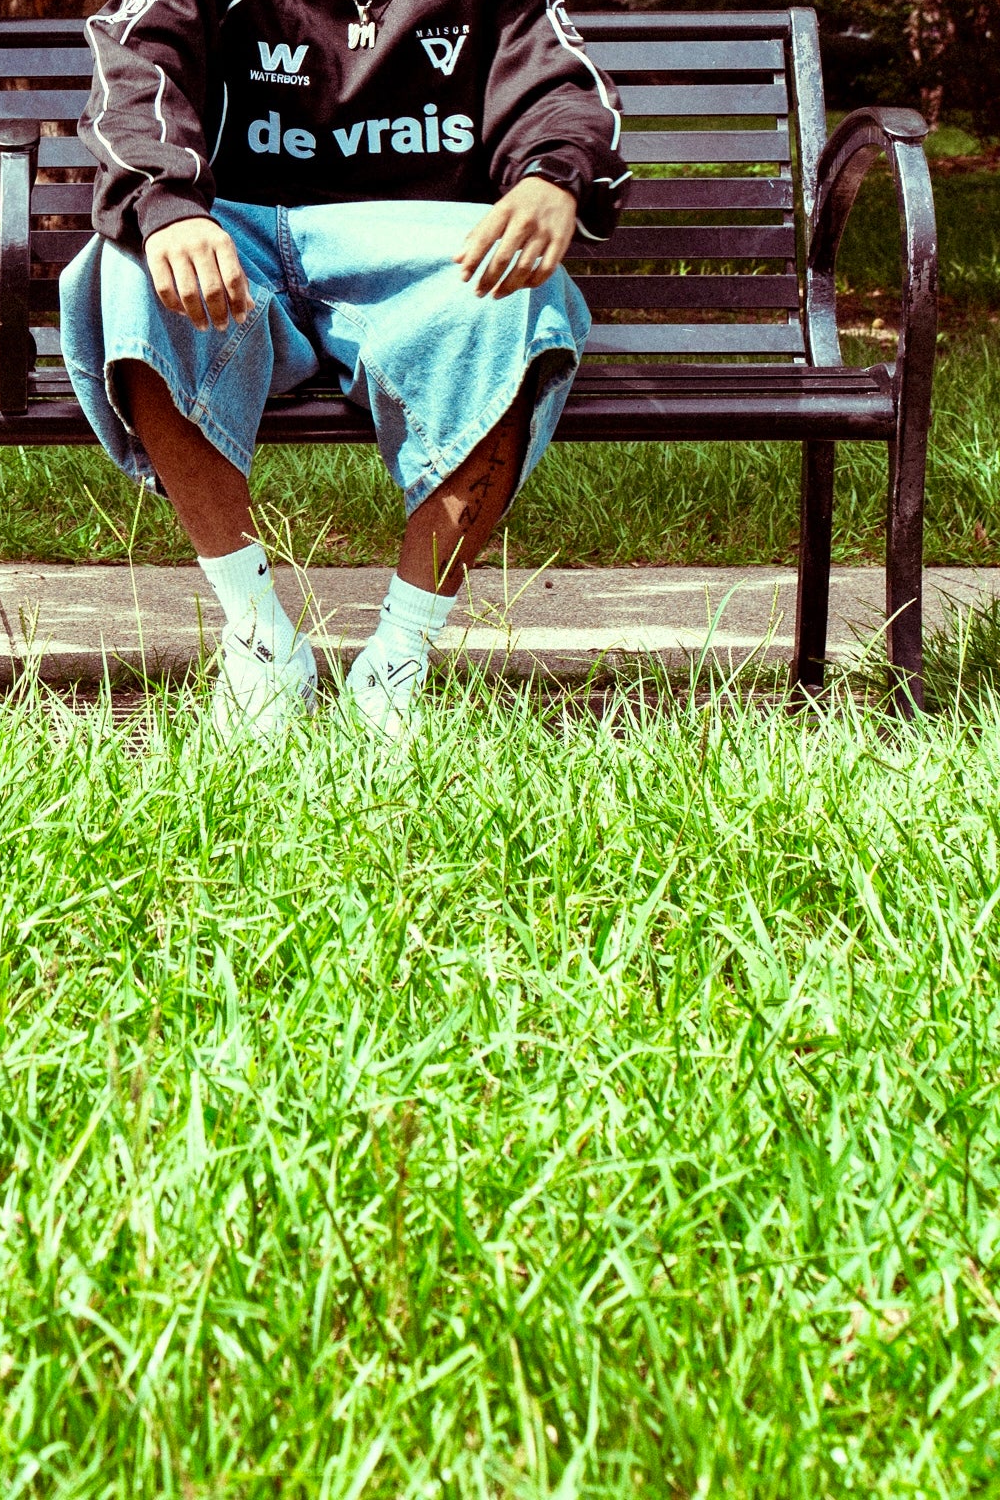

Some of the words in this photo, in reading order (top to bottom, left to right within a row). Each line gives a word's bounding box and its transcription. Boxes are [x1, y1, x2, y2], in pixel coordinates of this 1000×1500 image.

[257, 41, 309, 73] W
[249, 69, 310, 86] WATERBOYS
[247, 110, 317, 159] de
[332, 103, 475, 158] vrais
